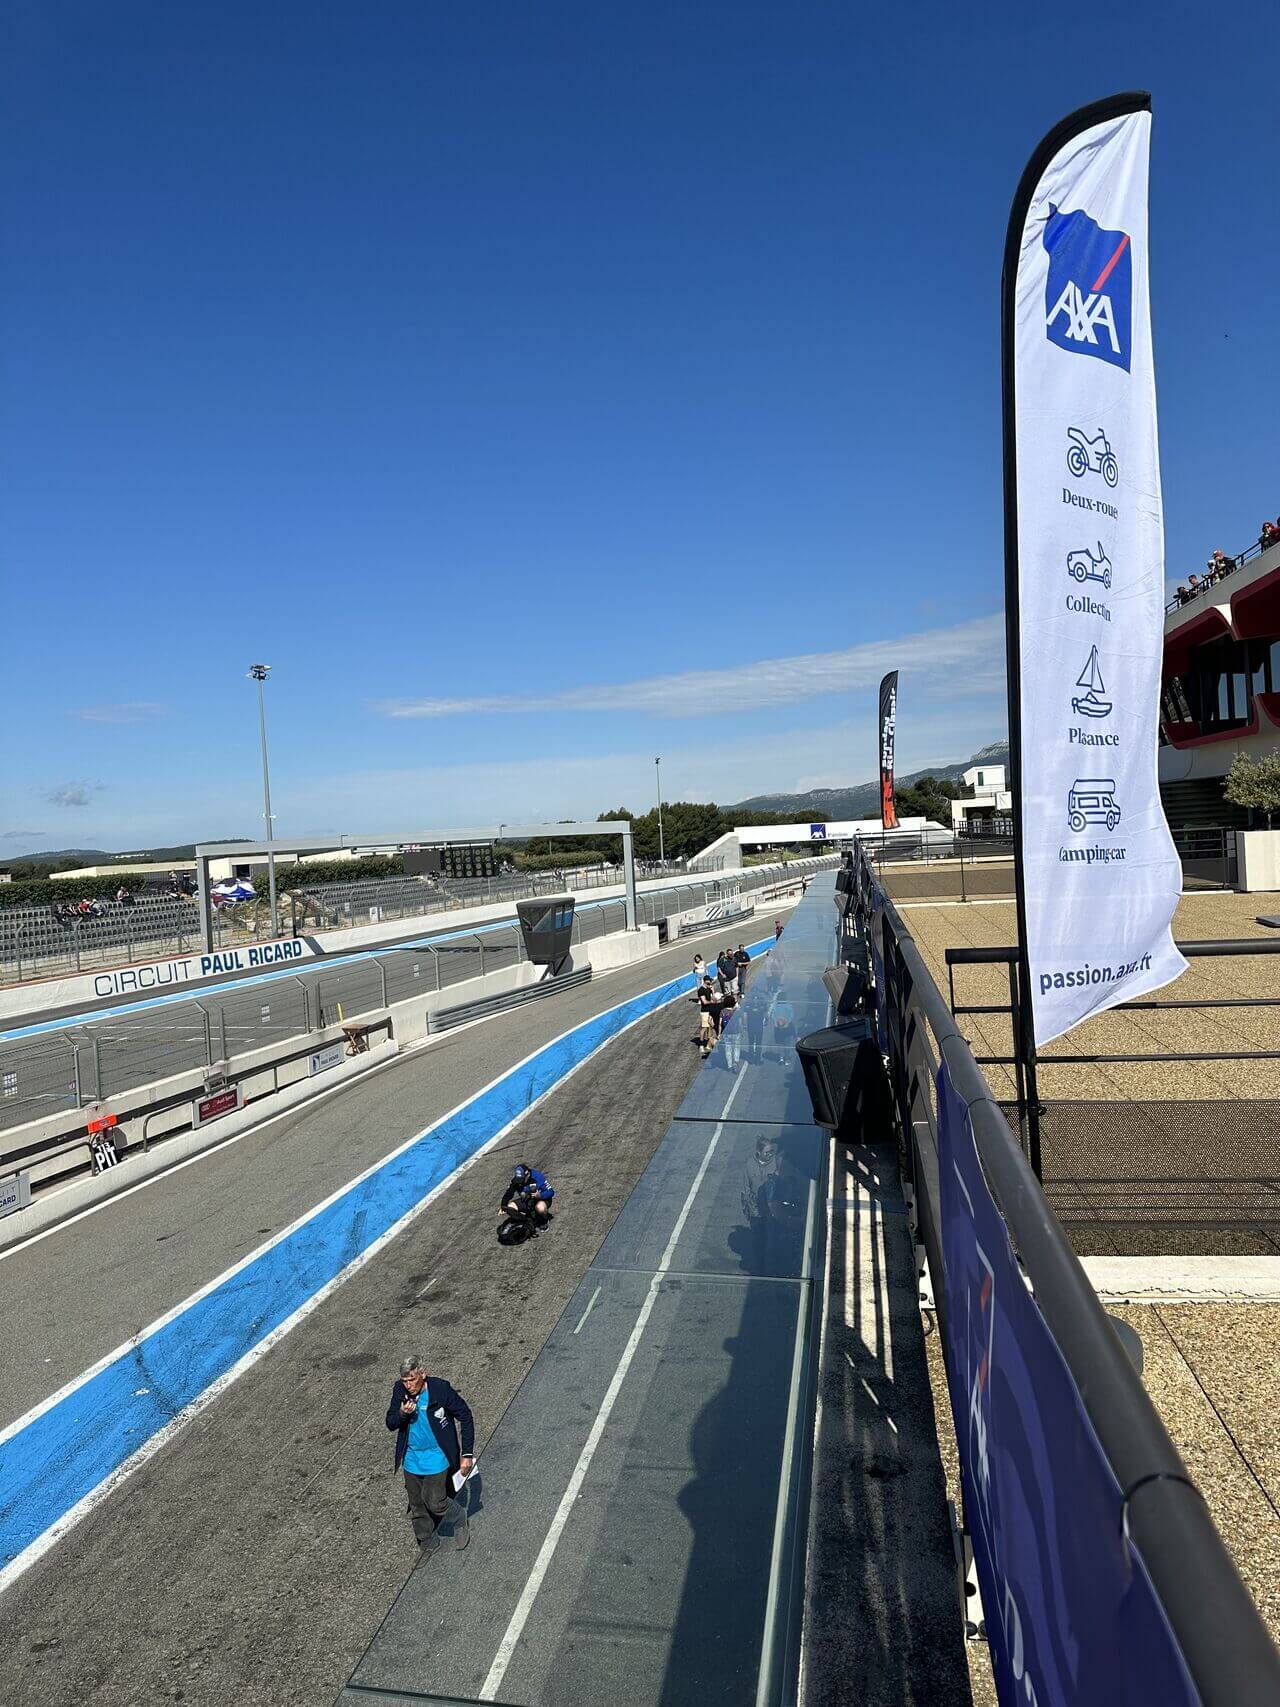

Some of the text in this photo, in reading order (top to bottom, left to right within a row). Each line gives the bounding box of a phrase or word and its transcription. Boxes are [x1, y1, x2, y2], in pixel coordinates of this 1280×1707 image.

[1047, 279, 1122, 354] AXA
[94, 940, 303, 997] CIRCUIT PAUL RICARD
[95, 1146, 118, 1171] PIT
